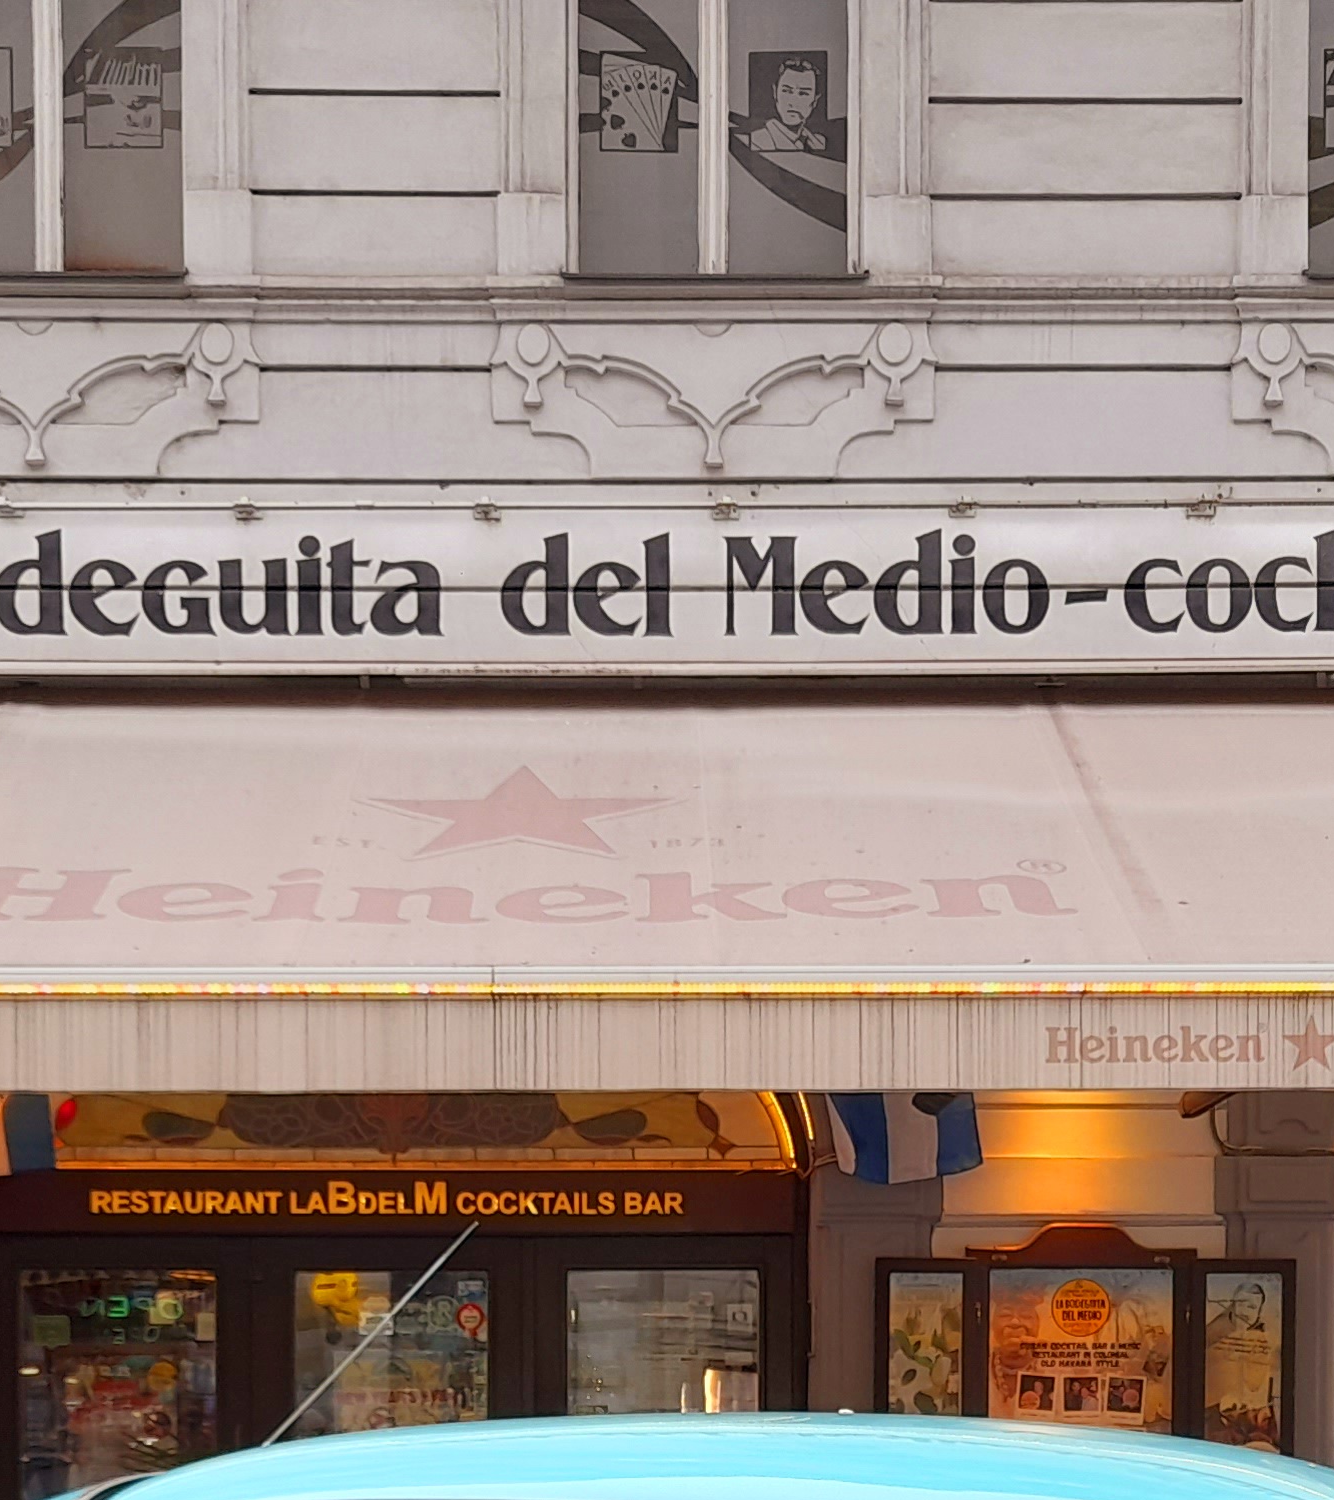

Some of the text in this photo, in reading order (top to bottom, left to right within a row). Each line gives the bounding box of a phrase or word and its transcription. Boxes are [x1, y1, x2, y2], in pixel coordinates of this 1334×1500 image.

[499, 531, 676, 638] del
[1044, 1025, 1266, 1064] Heineken
[88, 1190, 282, 1215] RESTAURANT
[455, 1190, 615, 1216] COCKTAILS
[624, 1190, 684, 1215] BAR
